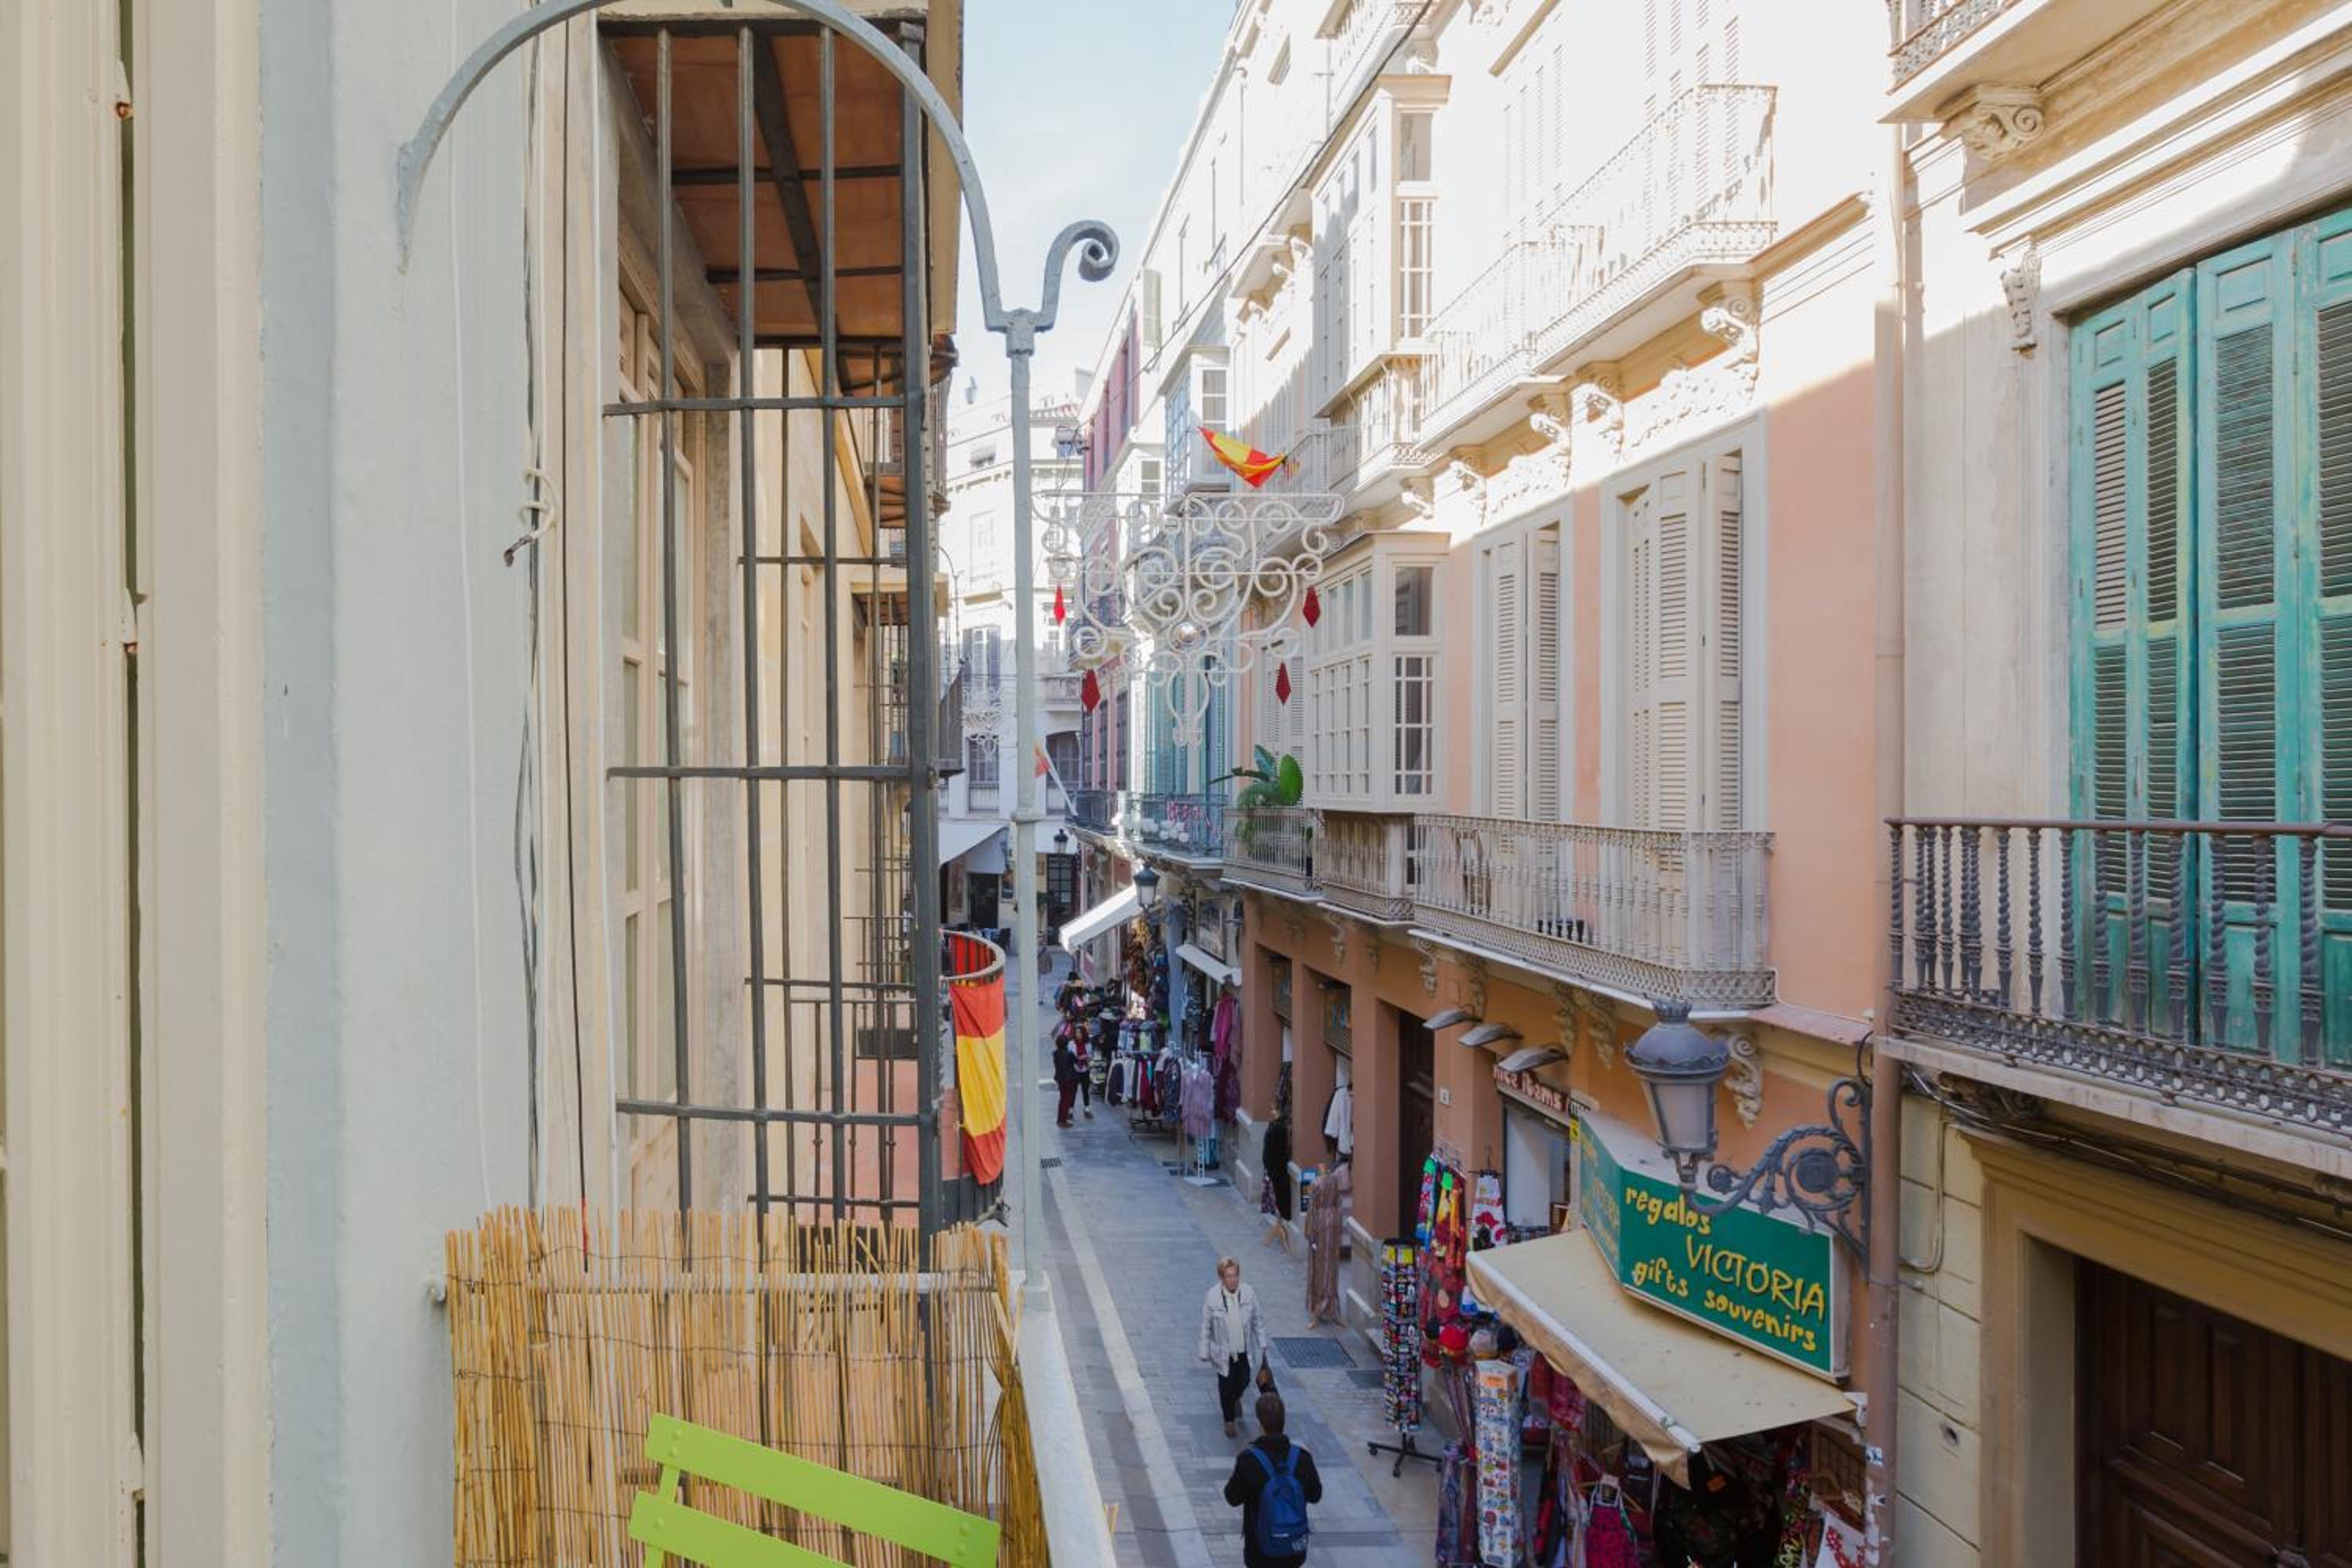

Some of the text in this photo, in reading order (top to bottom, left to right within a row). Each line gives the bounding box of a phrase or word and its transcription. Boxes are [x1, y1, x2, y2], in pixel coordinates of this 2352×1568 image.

[1625, 1187, 1712, 1234] regalos
[1632, 1258, 1817, 1352] gifts souvenirs
[1686, 1234, 1825, 1320] VICTORIA
